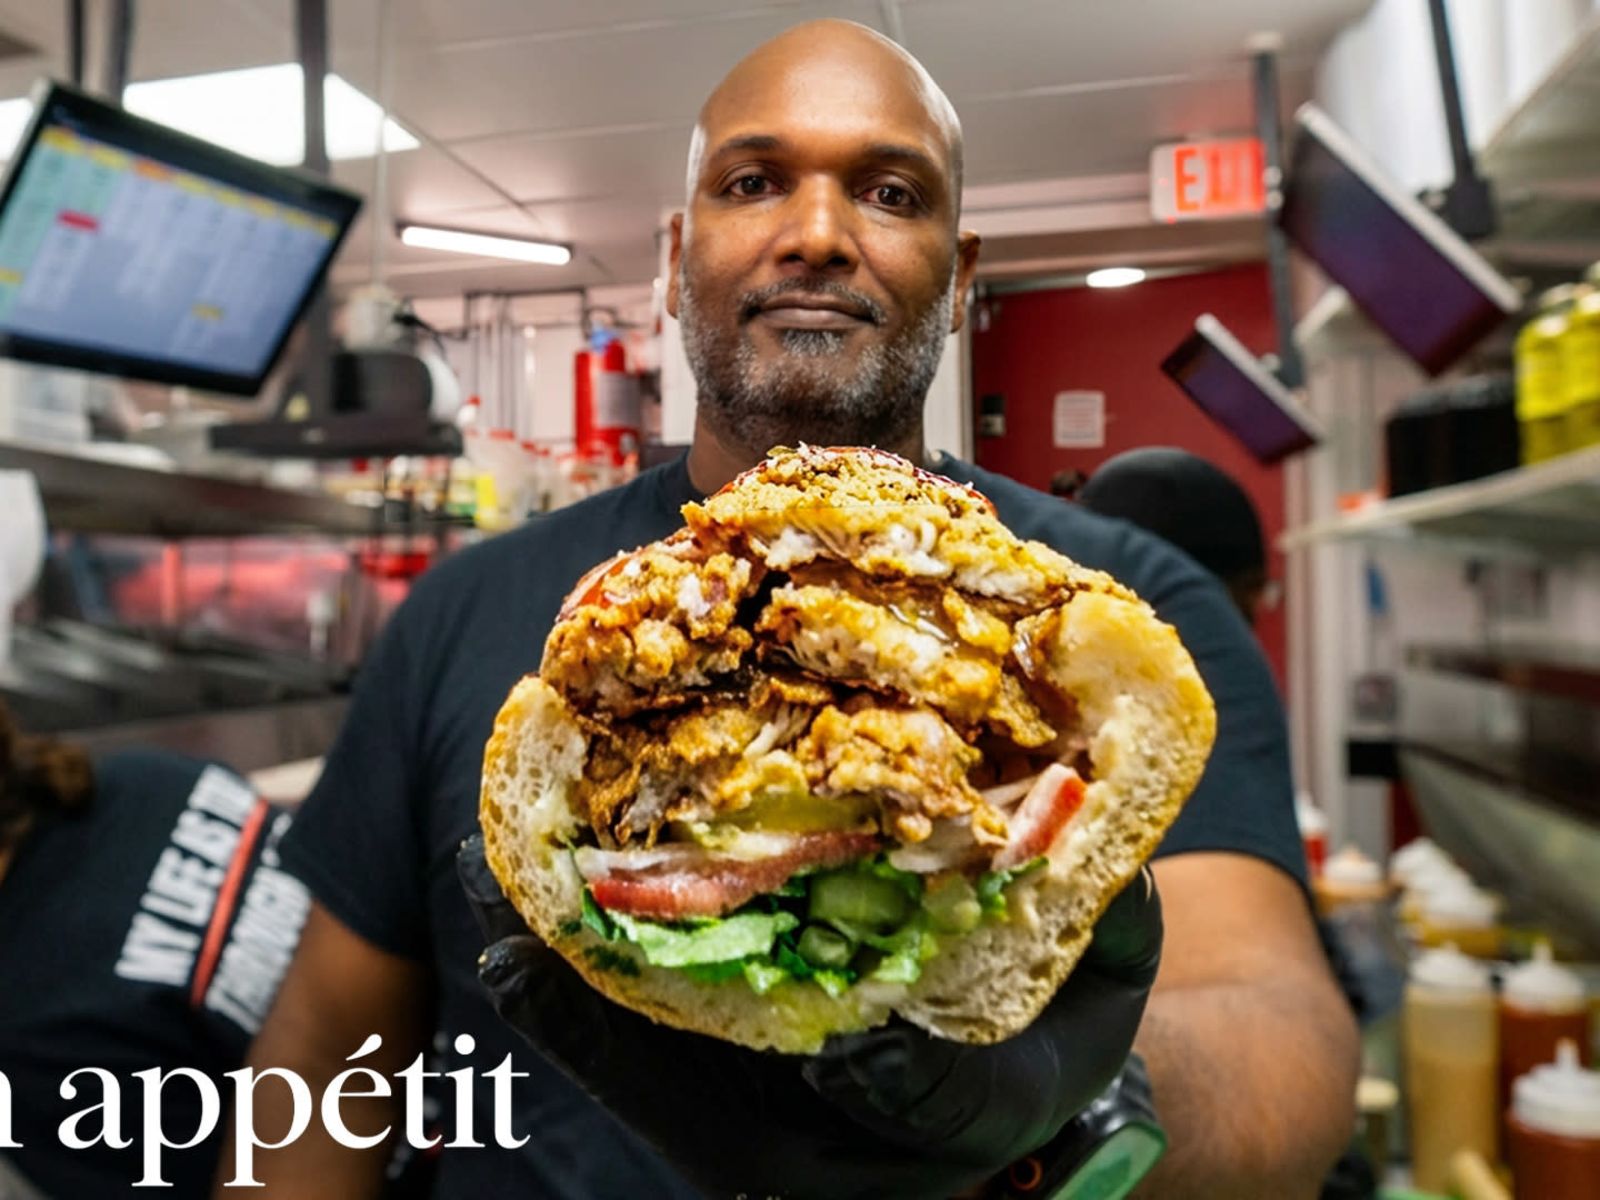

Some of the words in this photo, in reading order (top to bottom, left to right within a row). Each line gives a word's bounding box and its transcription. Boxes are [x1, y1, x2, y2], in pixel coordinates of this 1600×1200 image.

[170, 808, 242, 869] AS
[139, 846, 224, 928] LIFE
[113, 910, 202, 987] MY
